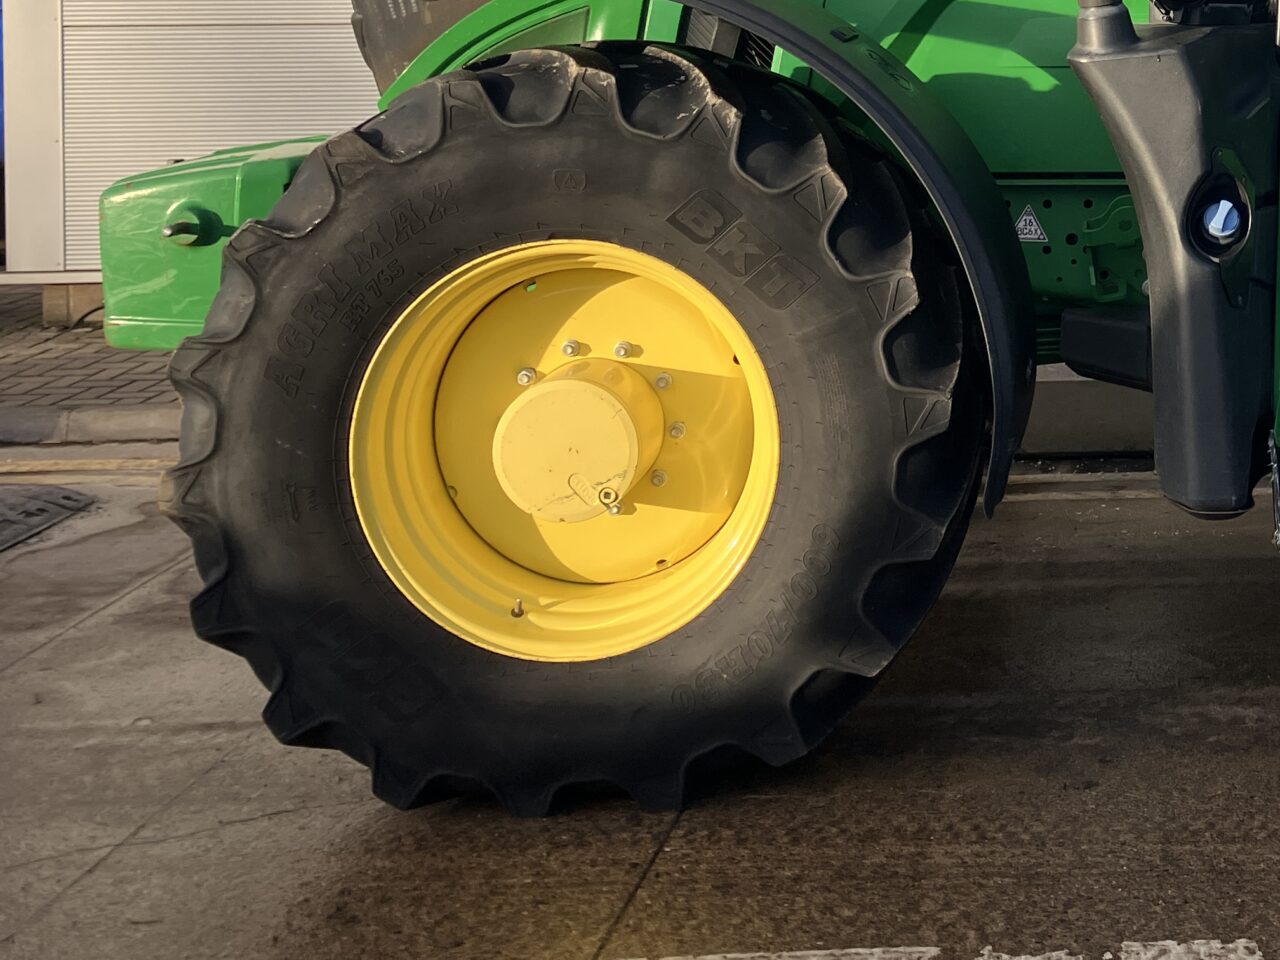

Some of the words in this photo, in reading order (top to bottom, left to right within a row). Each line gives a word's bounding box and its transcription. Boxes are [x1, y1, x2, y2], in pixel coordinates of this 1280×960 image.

[1022, 218, 1034, 227] 16
[671, 192, 815, 305] BKT
[365, 259, 406, 297] 765
